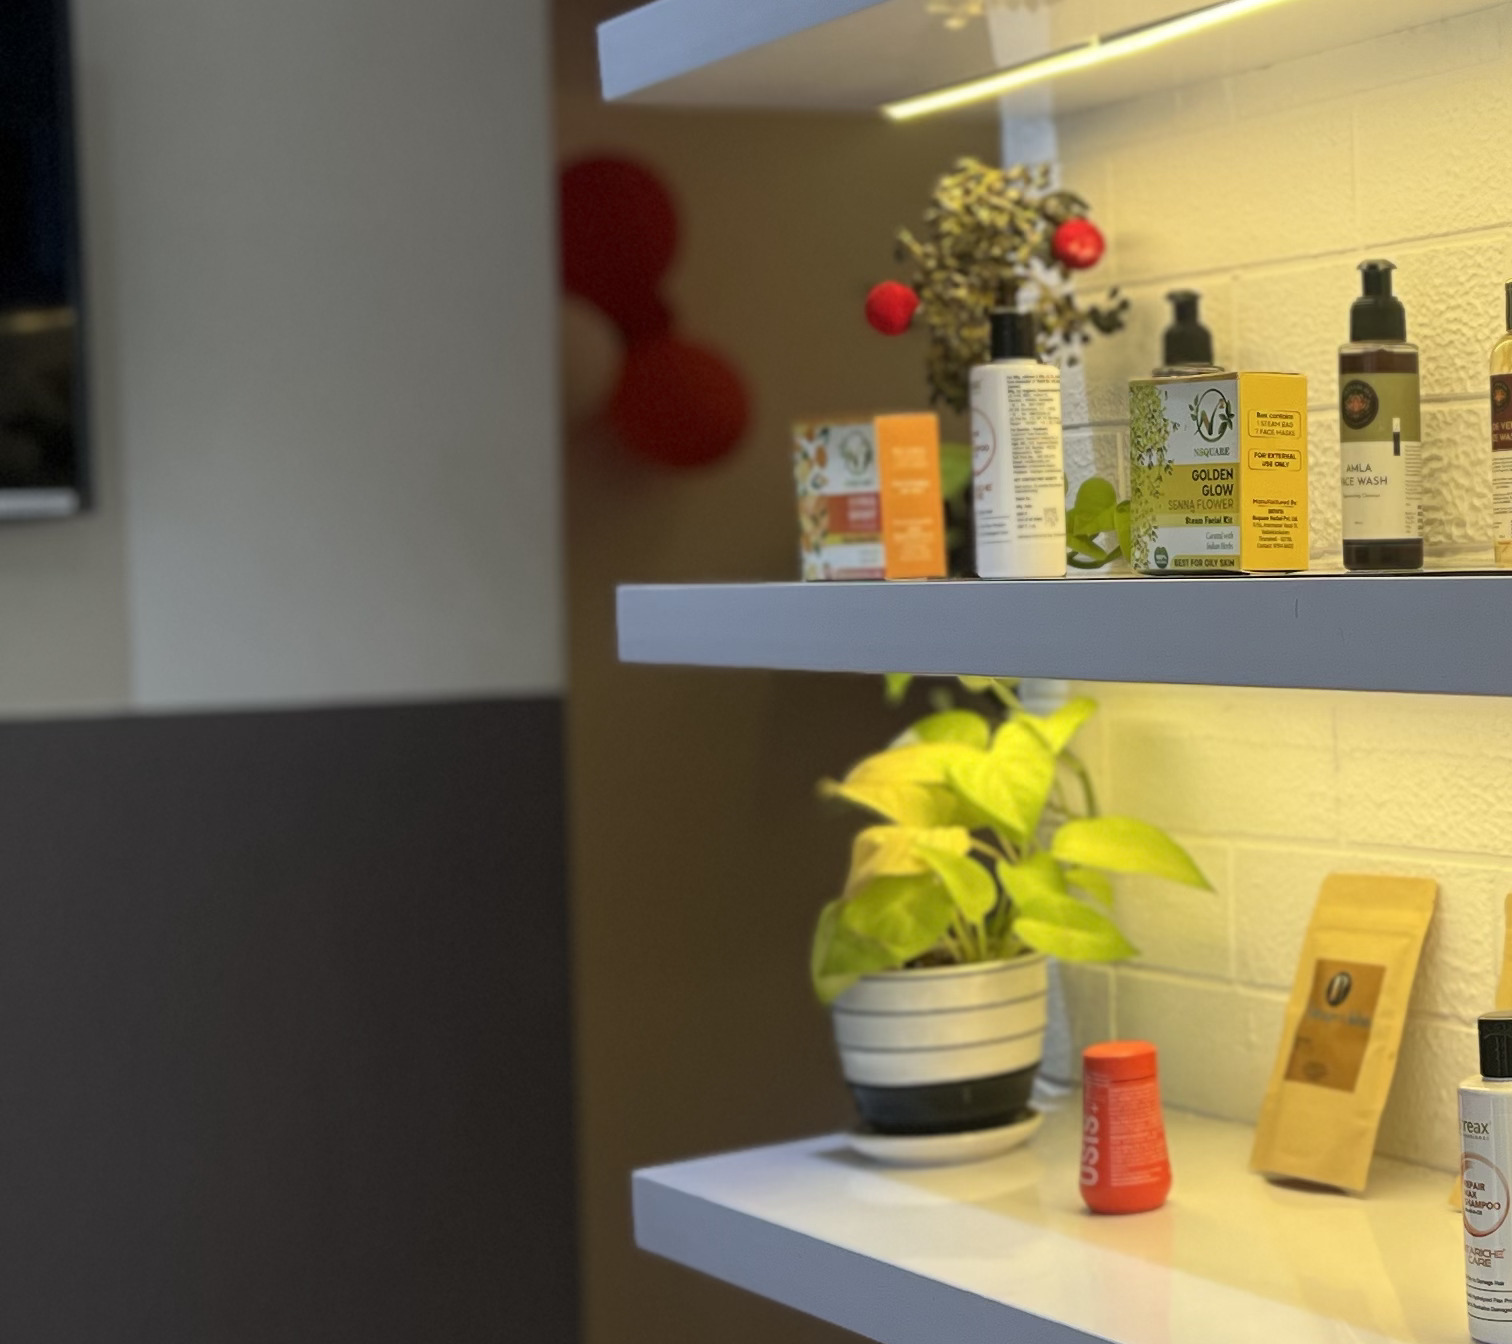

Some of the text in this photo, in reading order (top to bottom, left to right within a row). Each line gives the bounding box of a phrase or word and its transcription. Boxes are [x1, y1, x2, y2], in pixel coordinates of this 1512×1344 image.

[1346, 464, 1372, 472] AMLA
[1192, 468, 1233, 481] GOLDEN
[1357, 476, 1388, 486] WASH
[1202, 484, 1234, 496] GLOW
[1168, 498, 1233, 510] SENNA FLOWER
